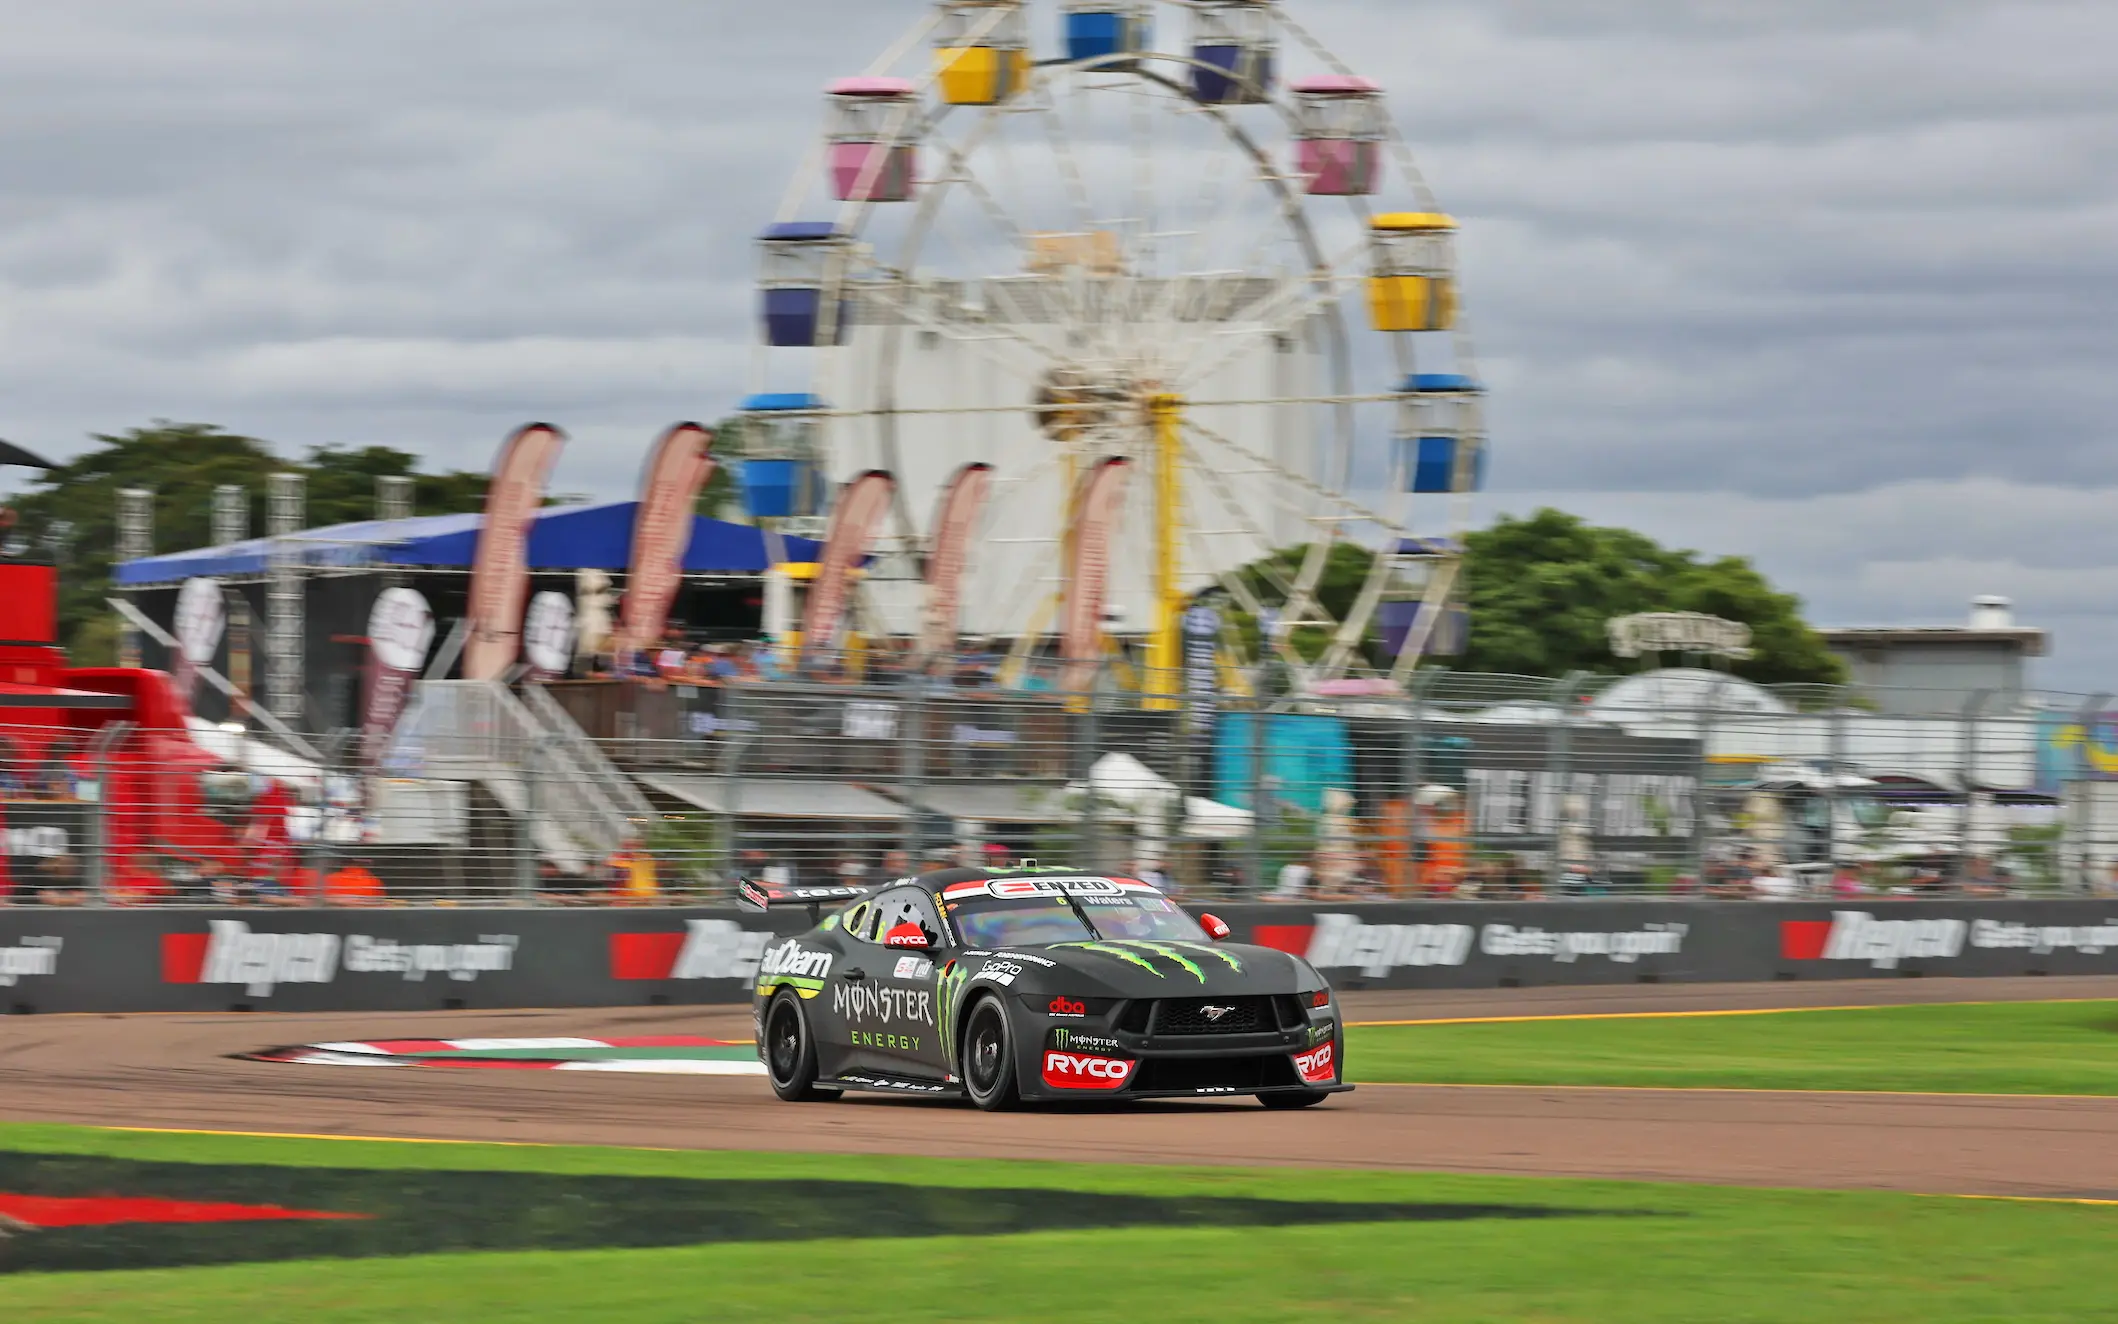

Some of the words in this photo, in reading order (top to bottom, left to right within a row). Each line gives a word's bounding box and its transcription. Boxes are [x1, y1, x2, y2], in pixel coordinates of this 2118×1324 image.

[1032, 881, 1109, 891] ENZED
[1056, 896, 1067, 905] 6
[1083, 896, 1133, 905] Waters
[890, 936, 928, 945] RYCO
[981, 960, 1023, 975] GoPro
[833, 979, 934, 1027] MONSTER
[1049, 995, 1085, 1013] dba
[851, 1030, 920, 1051] ENERGY
[1070, 1035, 1118, 1047] MONSTER
[1047, 1053, 1128, 1078] RYCO
[1294, 1045, 1331, 1075] RYCO
